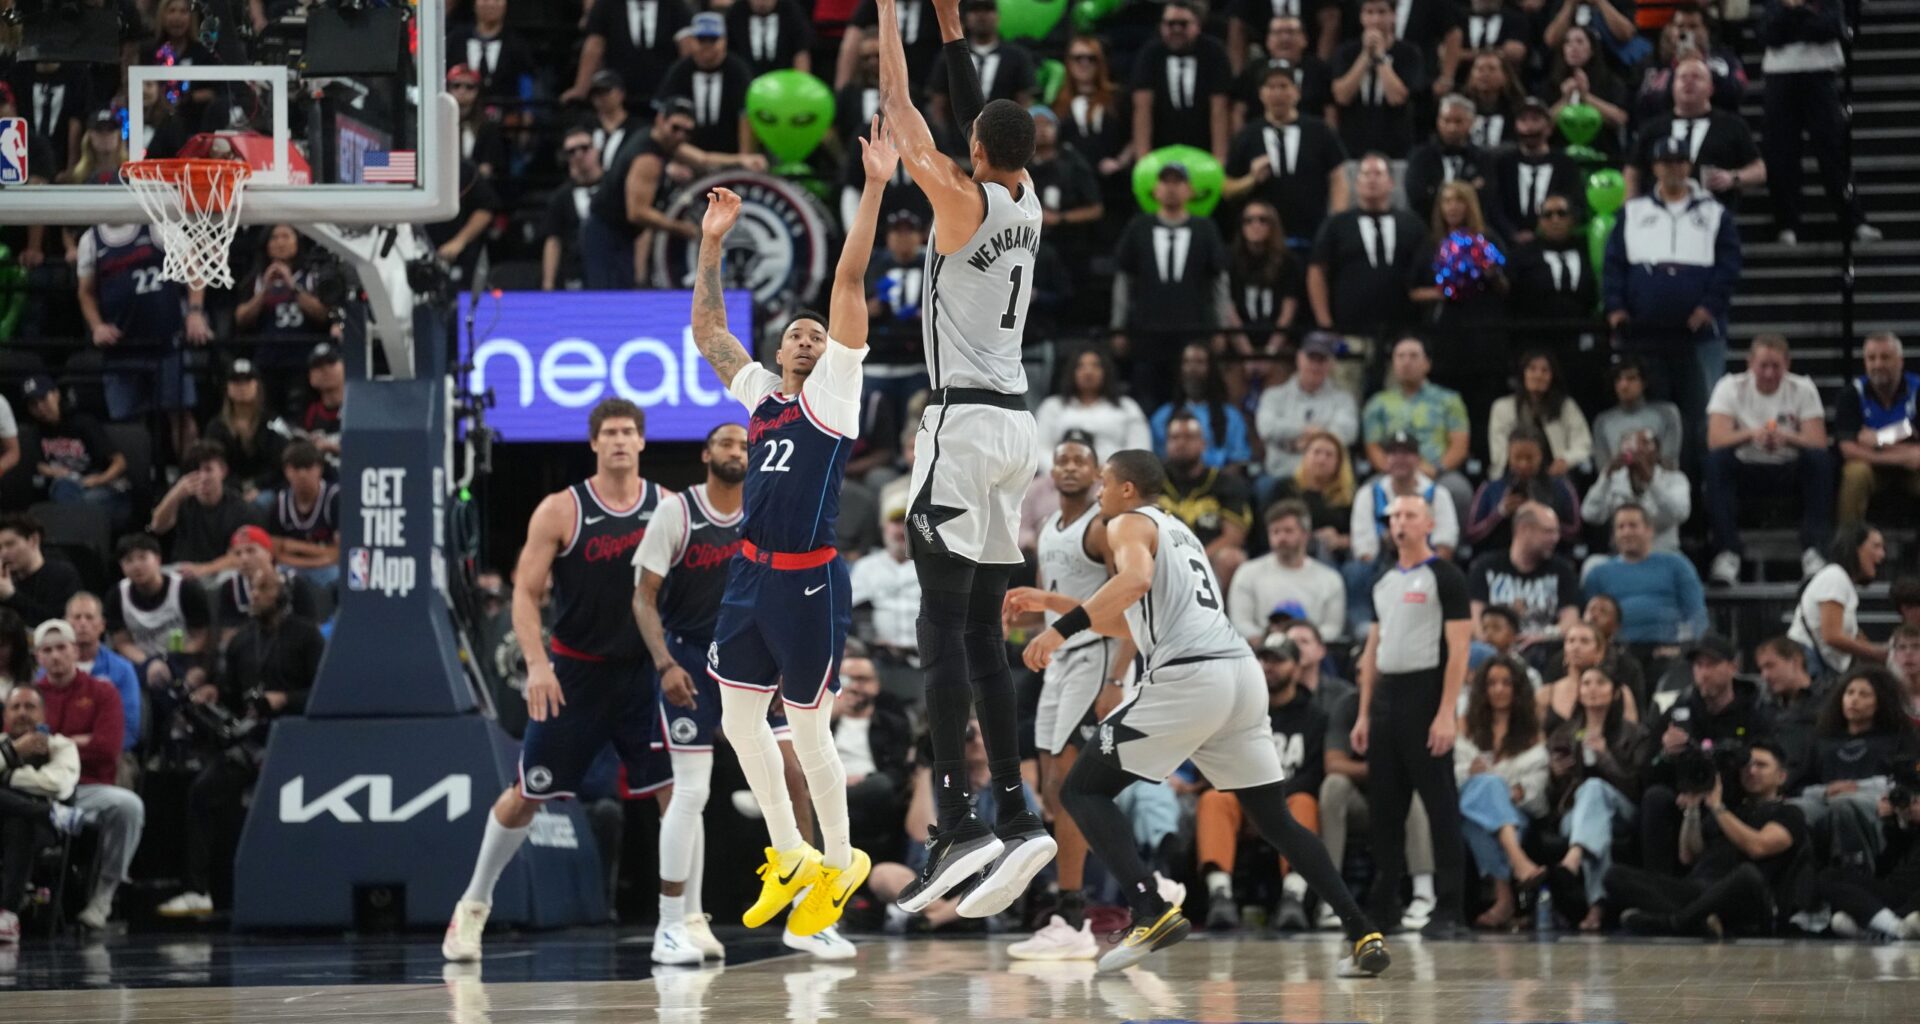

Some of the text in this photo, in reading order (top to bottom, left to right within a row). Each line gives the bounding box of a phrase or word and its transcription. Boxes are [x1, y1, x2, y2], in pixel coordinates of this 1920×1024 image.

[999, 263, 1024, 331] 1
[760, 438, 795, 473] 22
[361, 467, 406, 507] GET
[360, 508, 406, 547] THE
[370, 549, 416, 597] App
[1188, 556, 1220, 611] 3
